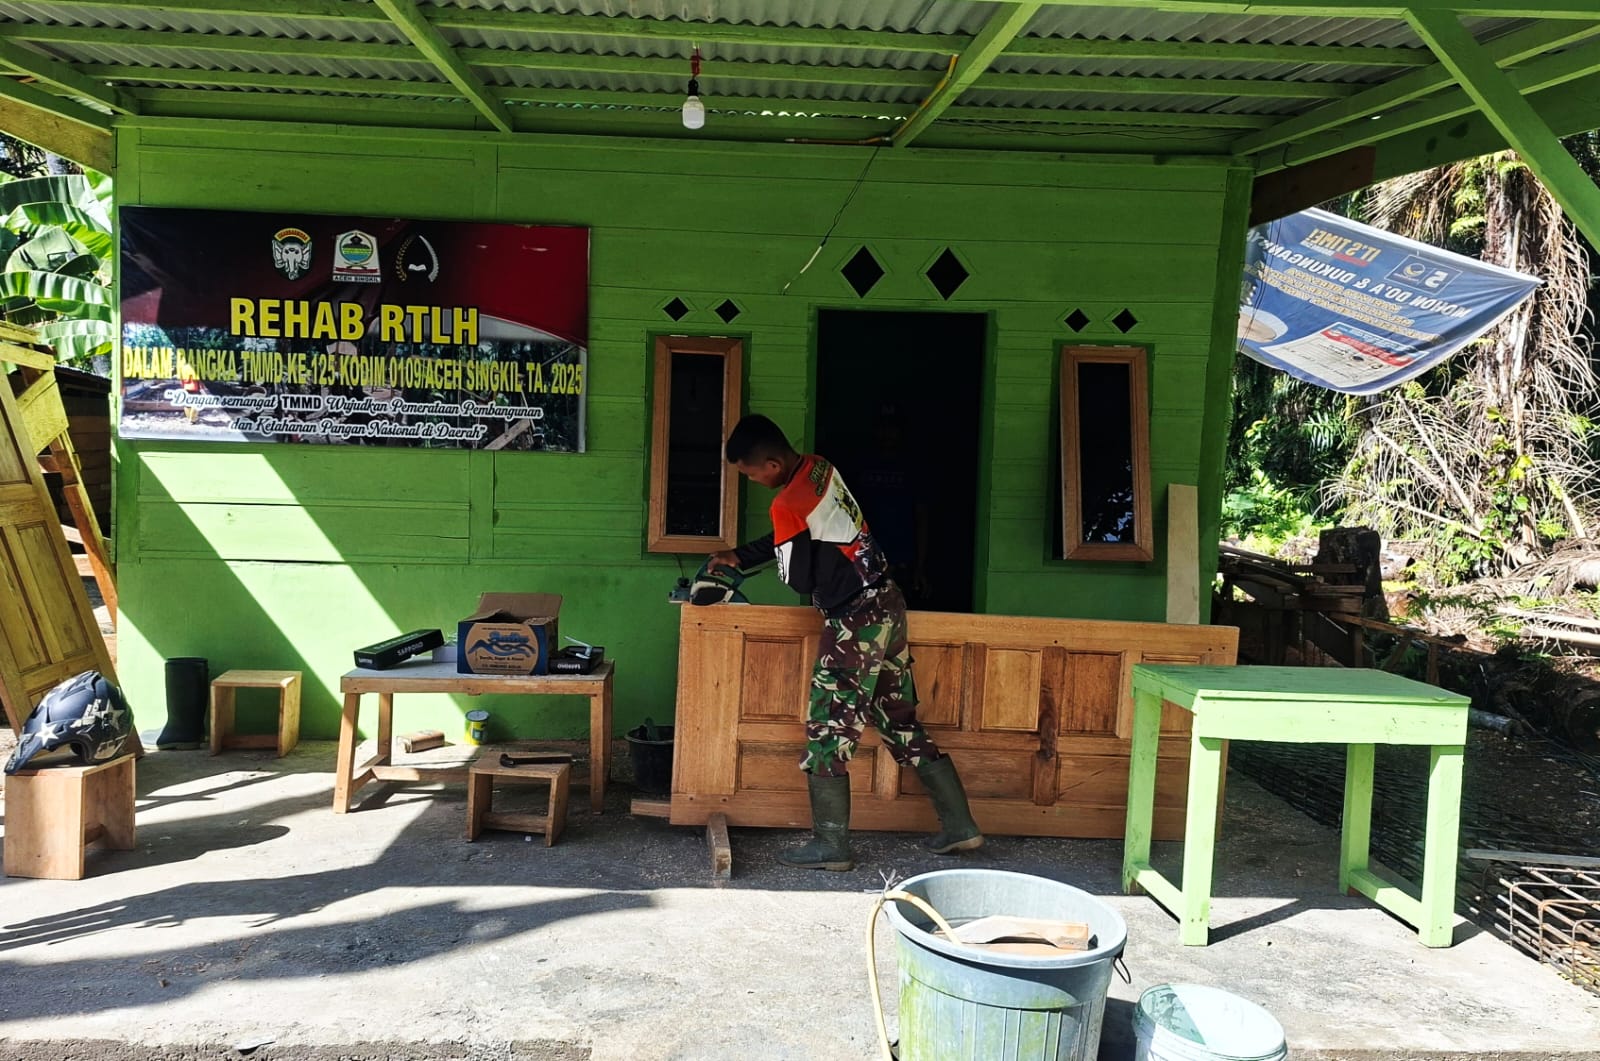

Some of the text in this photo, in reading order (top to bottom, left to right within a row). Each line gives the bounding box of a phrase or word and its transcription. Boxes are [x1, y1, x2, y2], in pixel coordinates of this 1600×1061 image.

[230, 297, 480, 346] REHAB RTLH
[123, 346, 172, 380] DALAM
[176, 348, 237, 381] RANGKA
[241, 351, 284, 384] TMMD
[340, 355, 385, 388] KODIM
[389, 357, 463, 390] 0109/ACEH
[466, 360, 523, 393] SINGKIL
[526, 363, 547, 394] TA.
[551, 363, 584, 395] 2025
[221, 396, 278, 413] semangat
[281, 395, 321, 410] TMMD
[326, 395, 388, 415] Wujudkan
[390, 398, 460, 416] Pemerataan
[461, 400, 544, 420] Pembangunan
[230, 415, 253, 432] dan
[255, 416, 317, 435] Ketahanan
[320, 418, 367, 437] Pangan
[366, 420, 422, 438] Nasional
[421, 423, 434, 438] di
